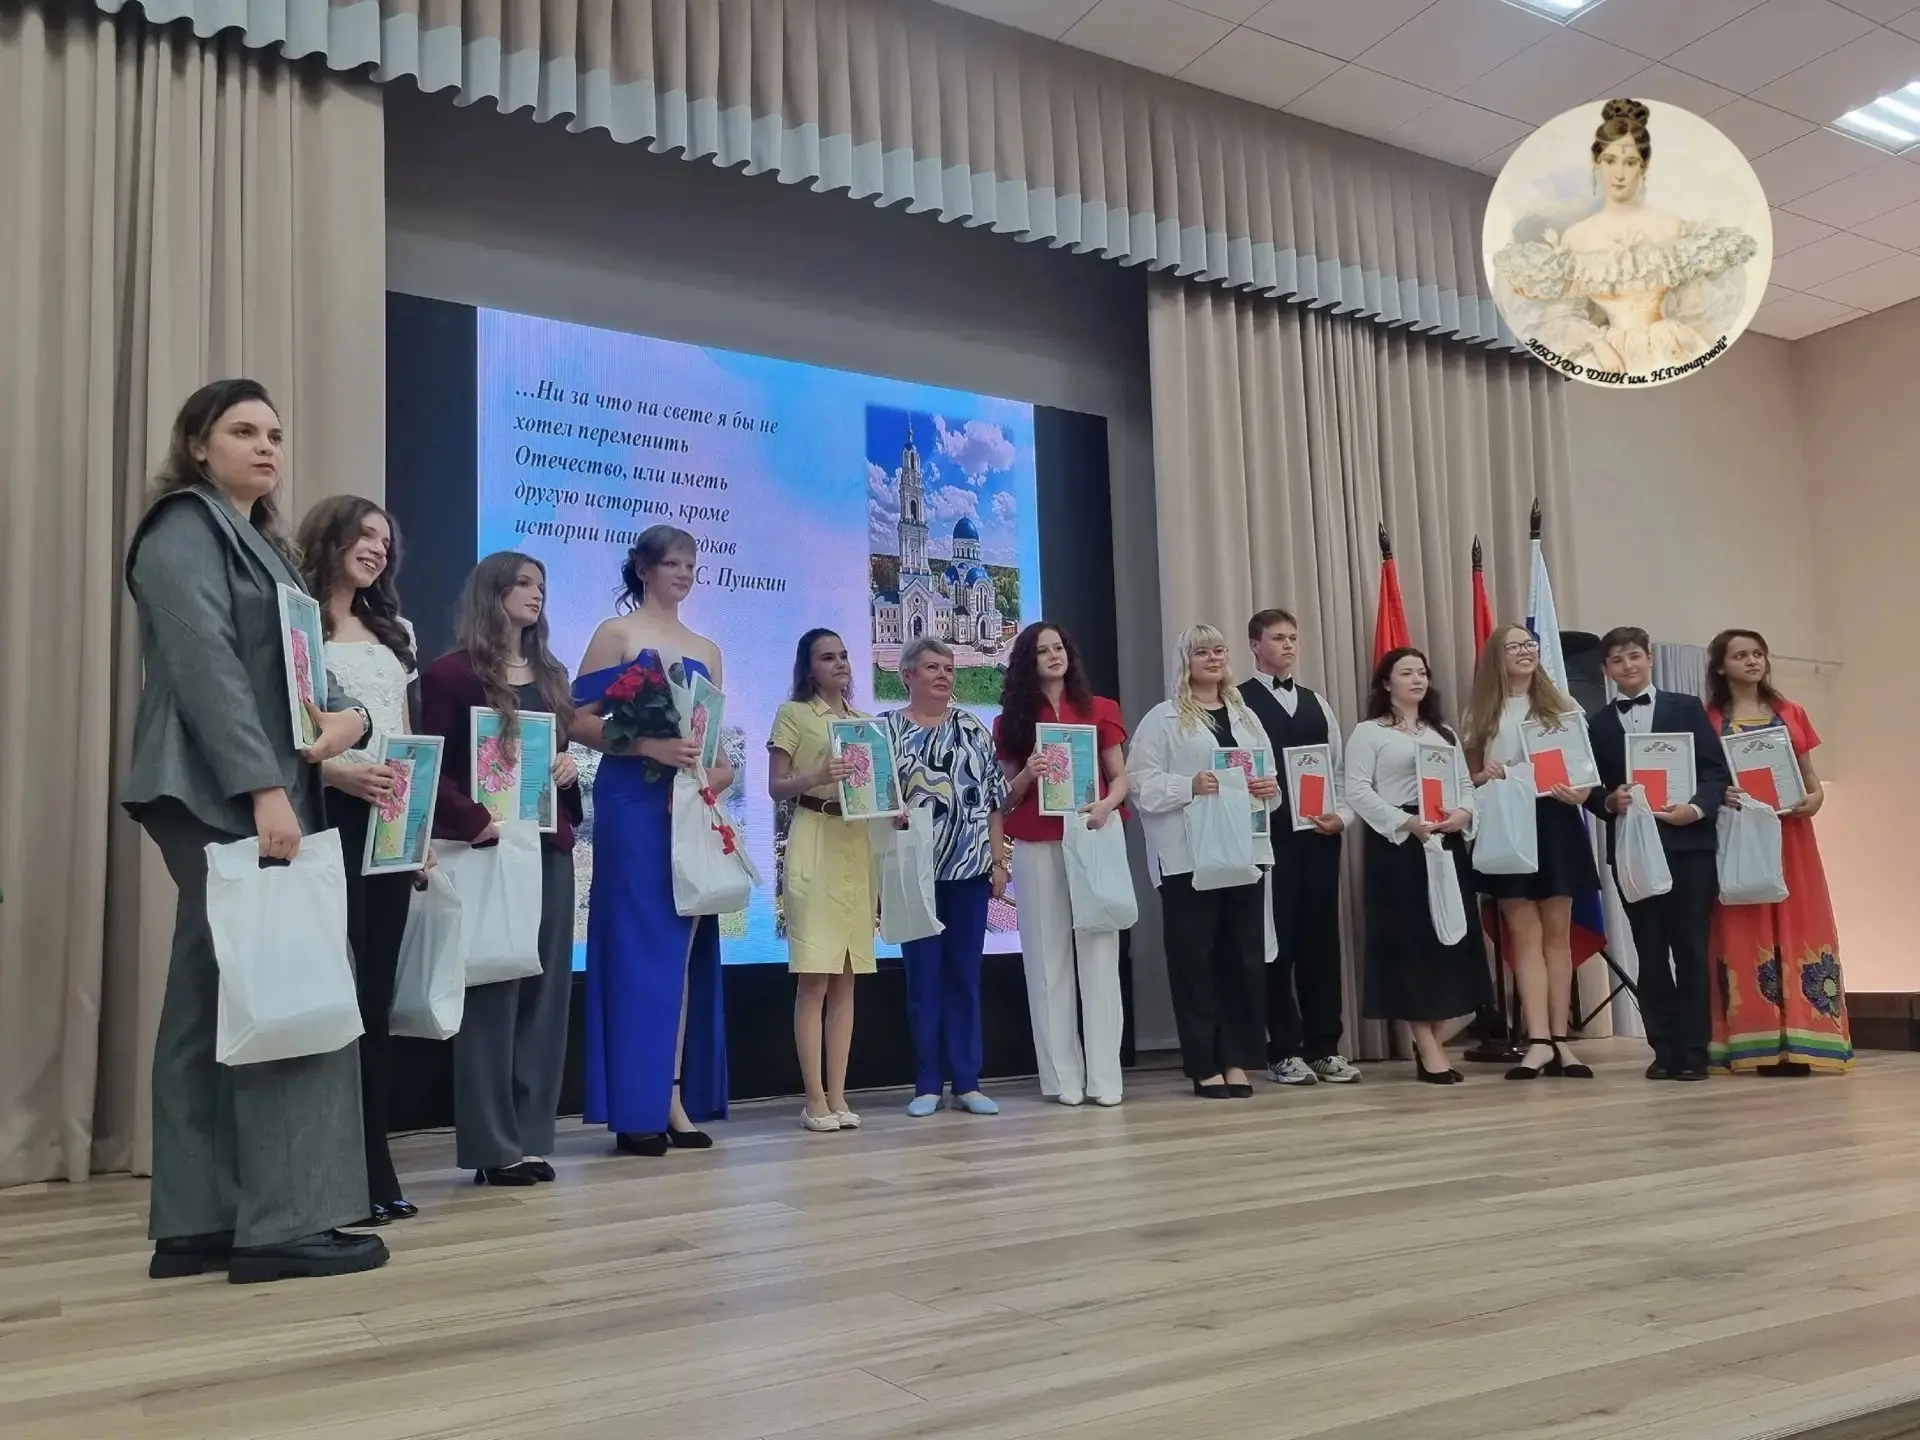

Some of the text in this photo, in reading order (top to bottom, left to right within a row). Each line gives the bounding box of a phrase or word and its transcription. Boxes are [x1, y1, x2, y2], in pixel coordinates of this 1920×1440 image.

[570, 391, 589, 407] за
[595, 395, 632, 413] что
[637, 400, 659, 417] на
[663, 404, 713, 425] свете
[717, 411, 727, 427] я
[732, 410, 755, 431] бы
[759, 417, 779, 434] не
[513, 415, 689, 454] хотел переменить
[515, 445, 728, 491] Отечество, или иметь
[514, 479, 730, 523] другую историю, кроме
[515, 519, 600, 543] истории
[717, 567, 787, 592] Пушкин
